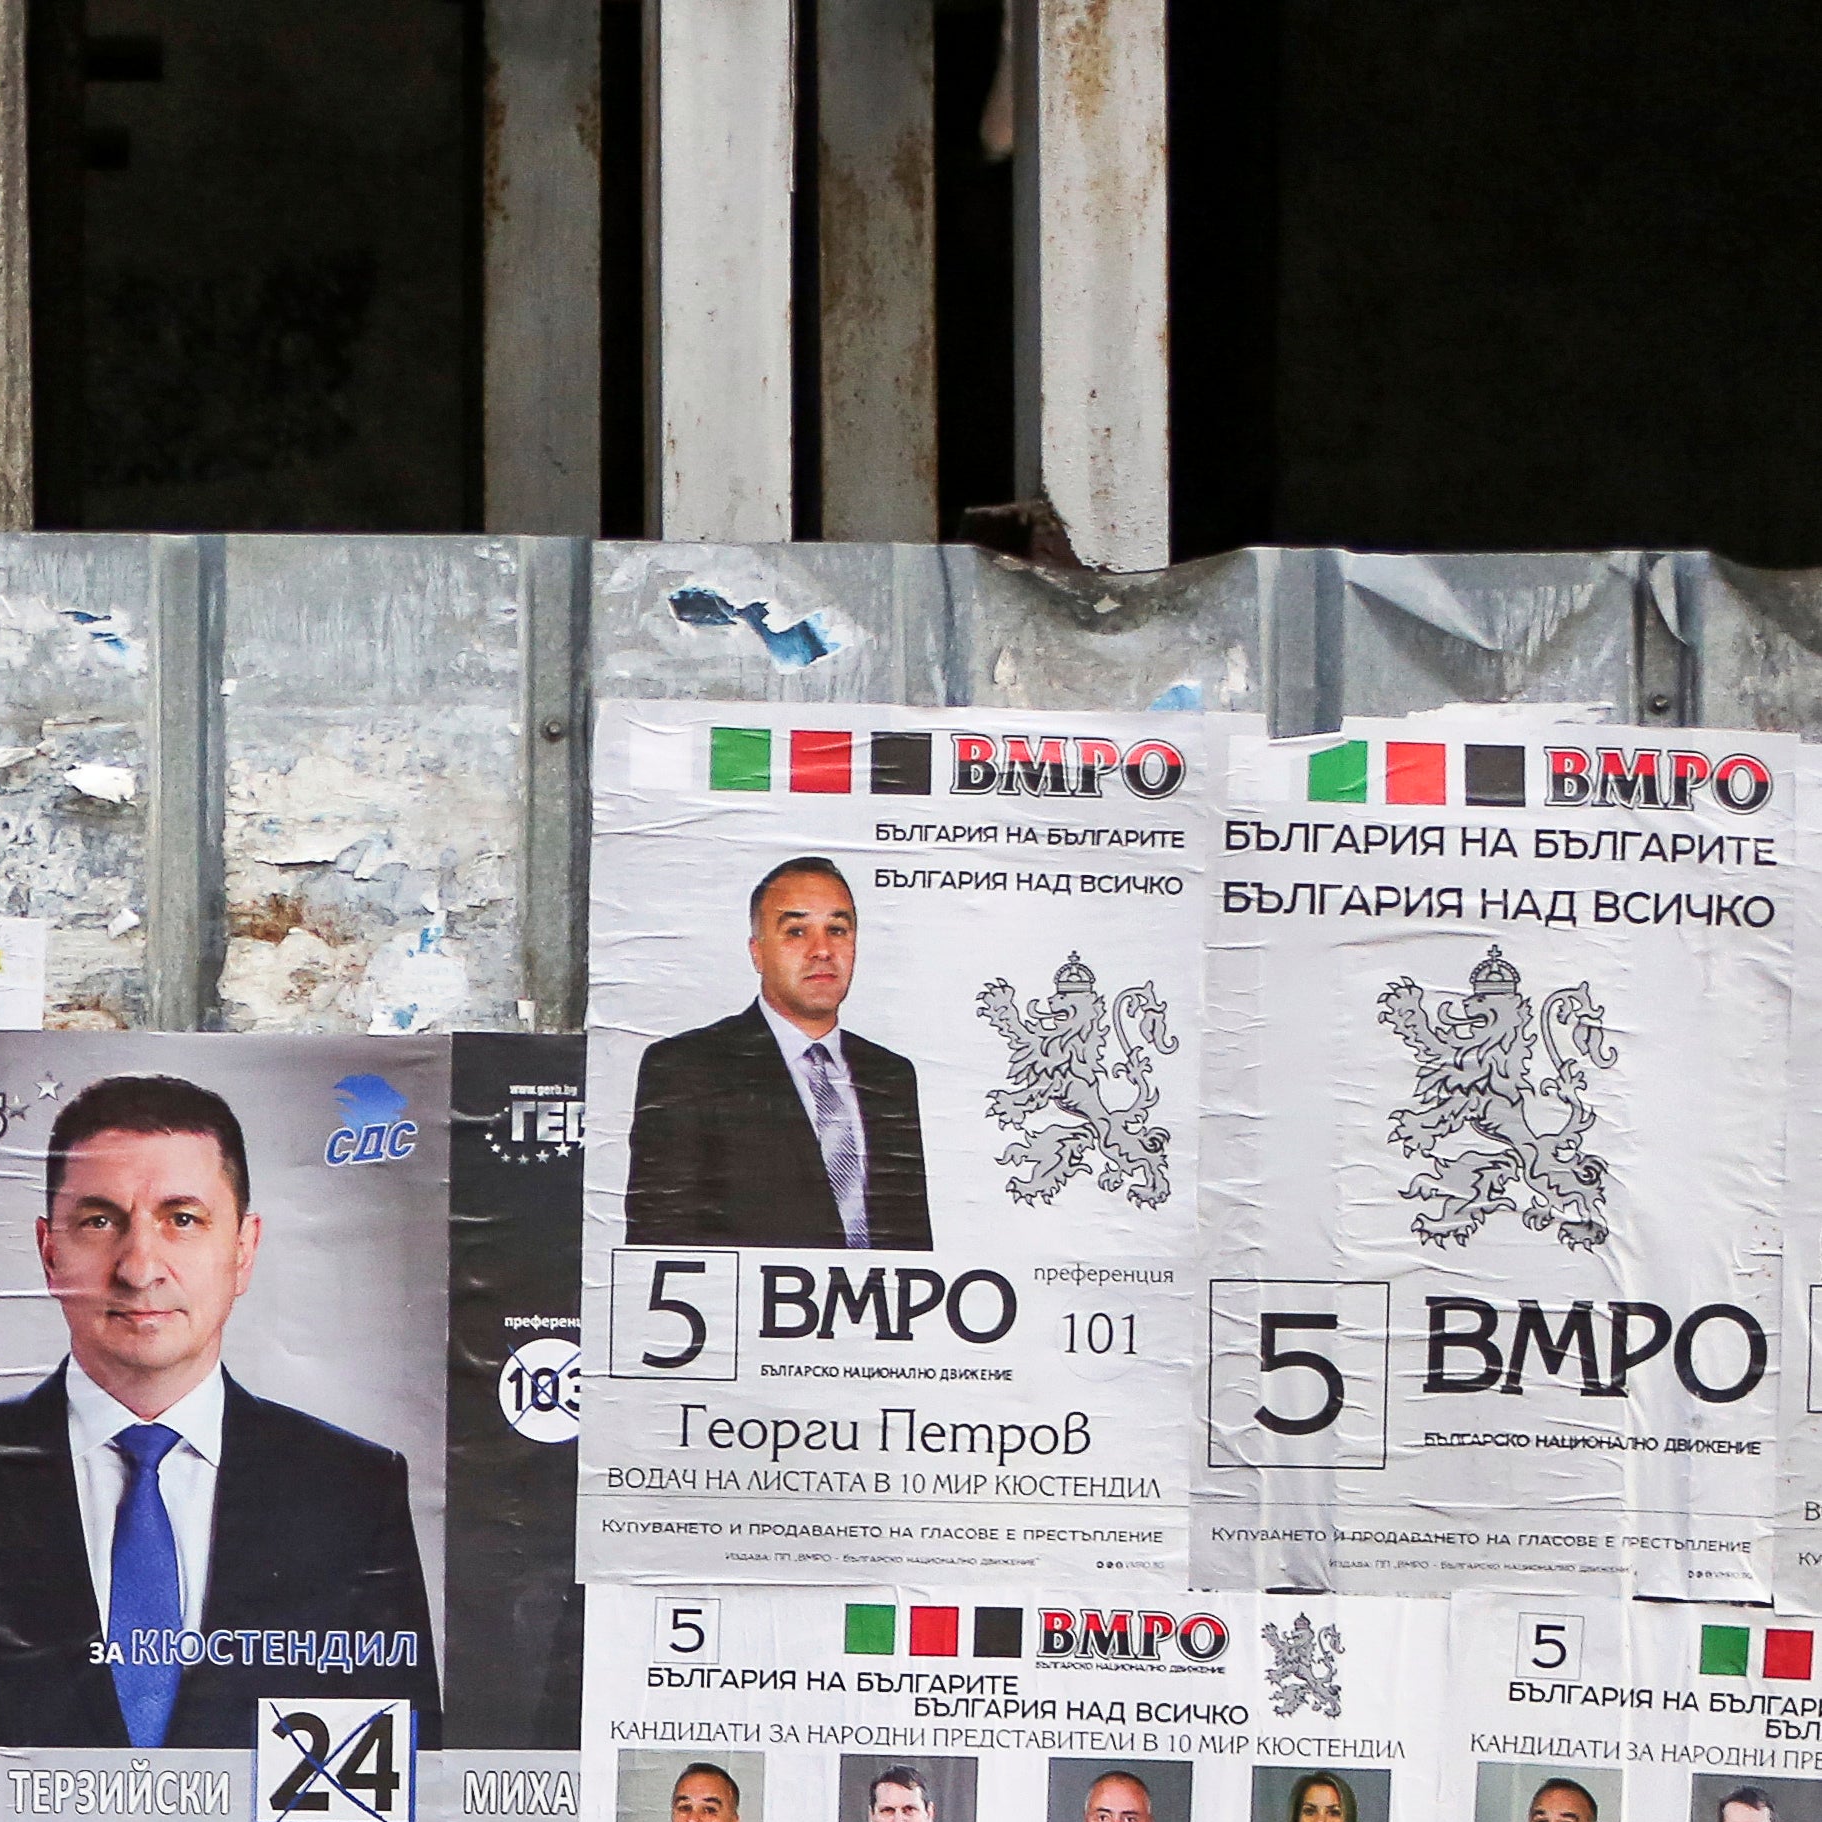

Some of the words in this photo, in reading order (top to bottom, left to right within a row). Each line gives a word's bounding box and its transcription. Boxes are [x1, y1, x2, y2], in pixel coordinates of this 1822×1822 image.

[950, 734, 1187, 801] ВМРО
[1545, 746, 1773, 815] ВМРО
[875, 823, 998, 844] БЪЛГАРИЯ
[1007, 825, 1037, 845] НА
[1047, 828, 1185, 849] БЪЛГАРИТЕ
[875, 869, 1008, 891] БЪЛГАРИЯ
[1016, 872, 1072, 895] НАД
[1081, 873, 1184, 896] ВСИЧКО
[323, 1120, 419, 1167] СДС
[1033, 1265, 1174, 1287] преференция
[641, 1260, 707, 1370] 5
[759, 1265, 1017, 1345] ВМРО
[1063, 1312, 1137, 1355] 101
[1422, 1297, 1768, 1404] ВМРО
[1255, 1312, 1344, 1435] 5
[679, 1404, 859, 1461] Георги
[878, 1408, 1091, 1467] Петров
[607, 1468, 698, 1491] ВОДАЧ
[706, 1470, 741, 1491] НА
[747, 1471, 866, 1493] ЛИСТАТА
[874, 1473, 890, 1493] В
[901, 1474, 925, 1493] 10
[934, 1475, 987, 1496] МИР
[994, 1476, 1160, 1500] КЮСТЕНДИЛ
[89, 1642, 125, 1666] ЗА
[130, 1629, 419, 1668] КЮСТЕНДИЛ
[668, 1607, 707, 1654] 5
[1036, 1607, 1230, 1663] ВМРО
[267, 1711, 401, 1814] 24
[12, 1765, 231, 1816] ТЕРЗИЙСКИ
